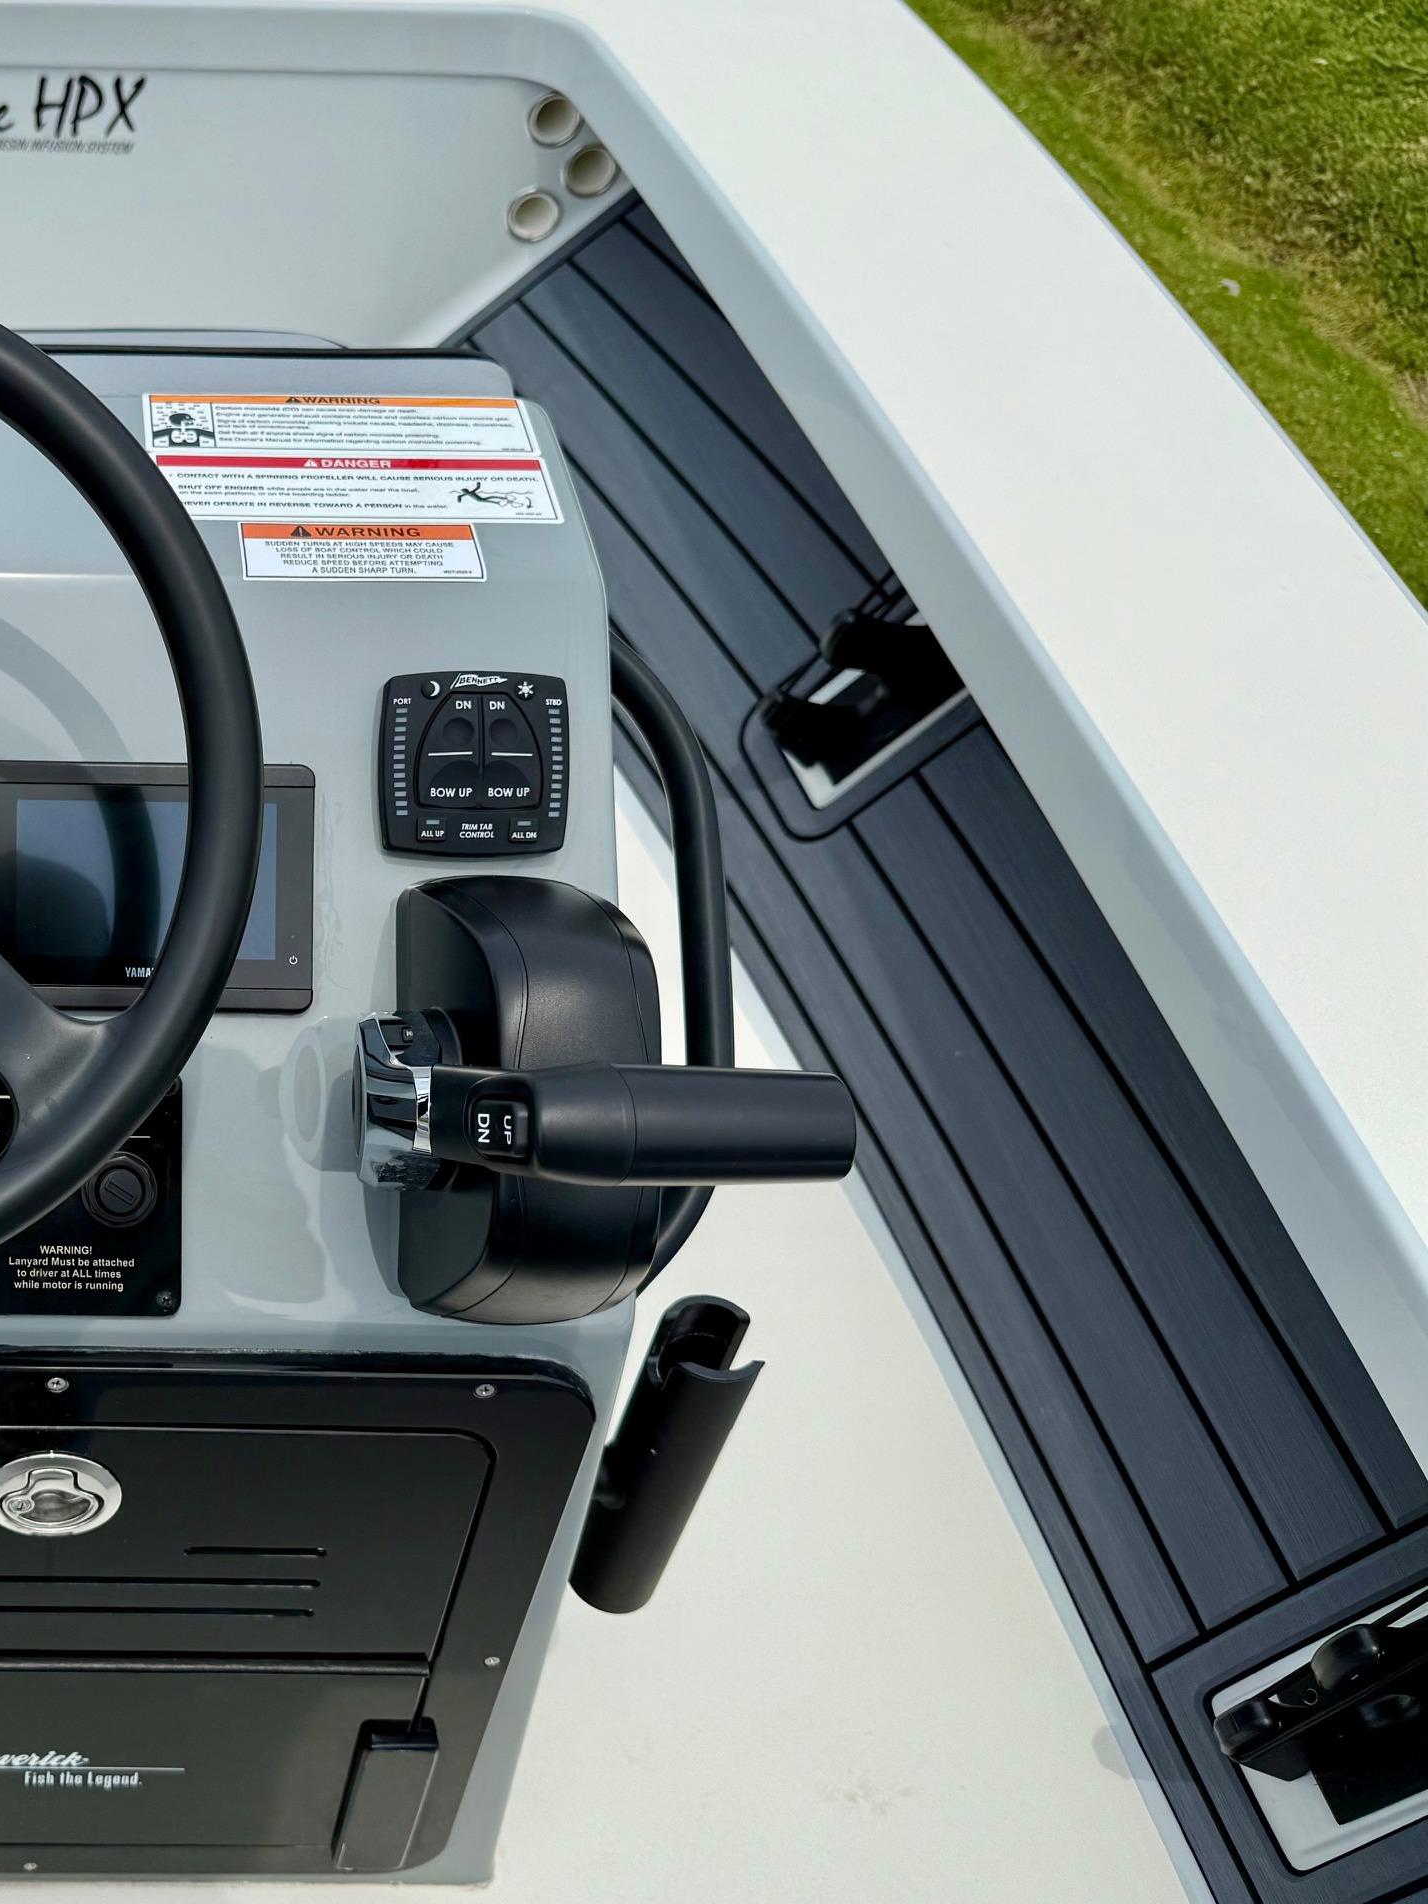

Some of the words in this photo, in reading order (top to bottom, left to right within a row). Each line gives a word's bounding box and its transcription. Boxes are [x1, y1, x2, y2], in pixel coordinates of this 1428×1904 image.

[34, 73, 147, 138] HPX
[303, 396, 380, 405] WARNING
[322, 459, 391, 469] DANGER
[315, 527, 420, 537] WARNING
[312, 566, 319, 574] A
[320, 566, 356, 574] SUDDEN
[358, 566, 388, 574] SHARP
[458, 676, 499, 685] BENNETT
[455, 700, 472, 709] DN
[489, 701, 505, 710] DN
[430, 787, 456, 797] BOW
[458, 787, 472, 797] UP
[488, 787, 514, 797] BOW
[516, 787, 530, 797] UP
[124, 966, 154, 978] YAMA
[477, 1113, 491, 1143] DN
[503, 1115, 512, 1146] UP
[39, 1245, 92, 1255] WARNING!
[8, 1256, 48, 1267] Lanyard
[51, 1256, 75, 1266] Must
[77, 1257, 90, 1267] be
[92, 1258, 135, 1267] attached
[16, 1268, 27, 1277] to
[29, 1268, 59, 1278] driver
[60, 1269, 70, 1278] at
[72, 1269, 93, 1278] ALL
[94, 1269, 121, 1278] times
[13, 1279, 40, 1289] while
[42, 1280, 72, 1289] motor
[74, 1280, 83, 1290] is
[85, 1280, 124, 1292] running
[24, 1771, 54, 1786] Fish
[59, 1771, 83, 1786] the
[87, 1771, 142, 1788] Legend.
